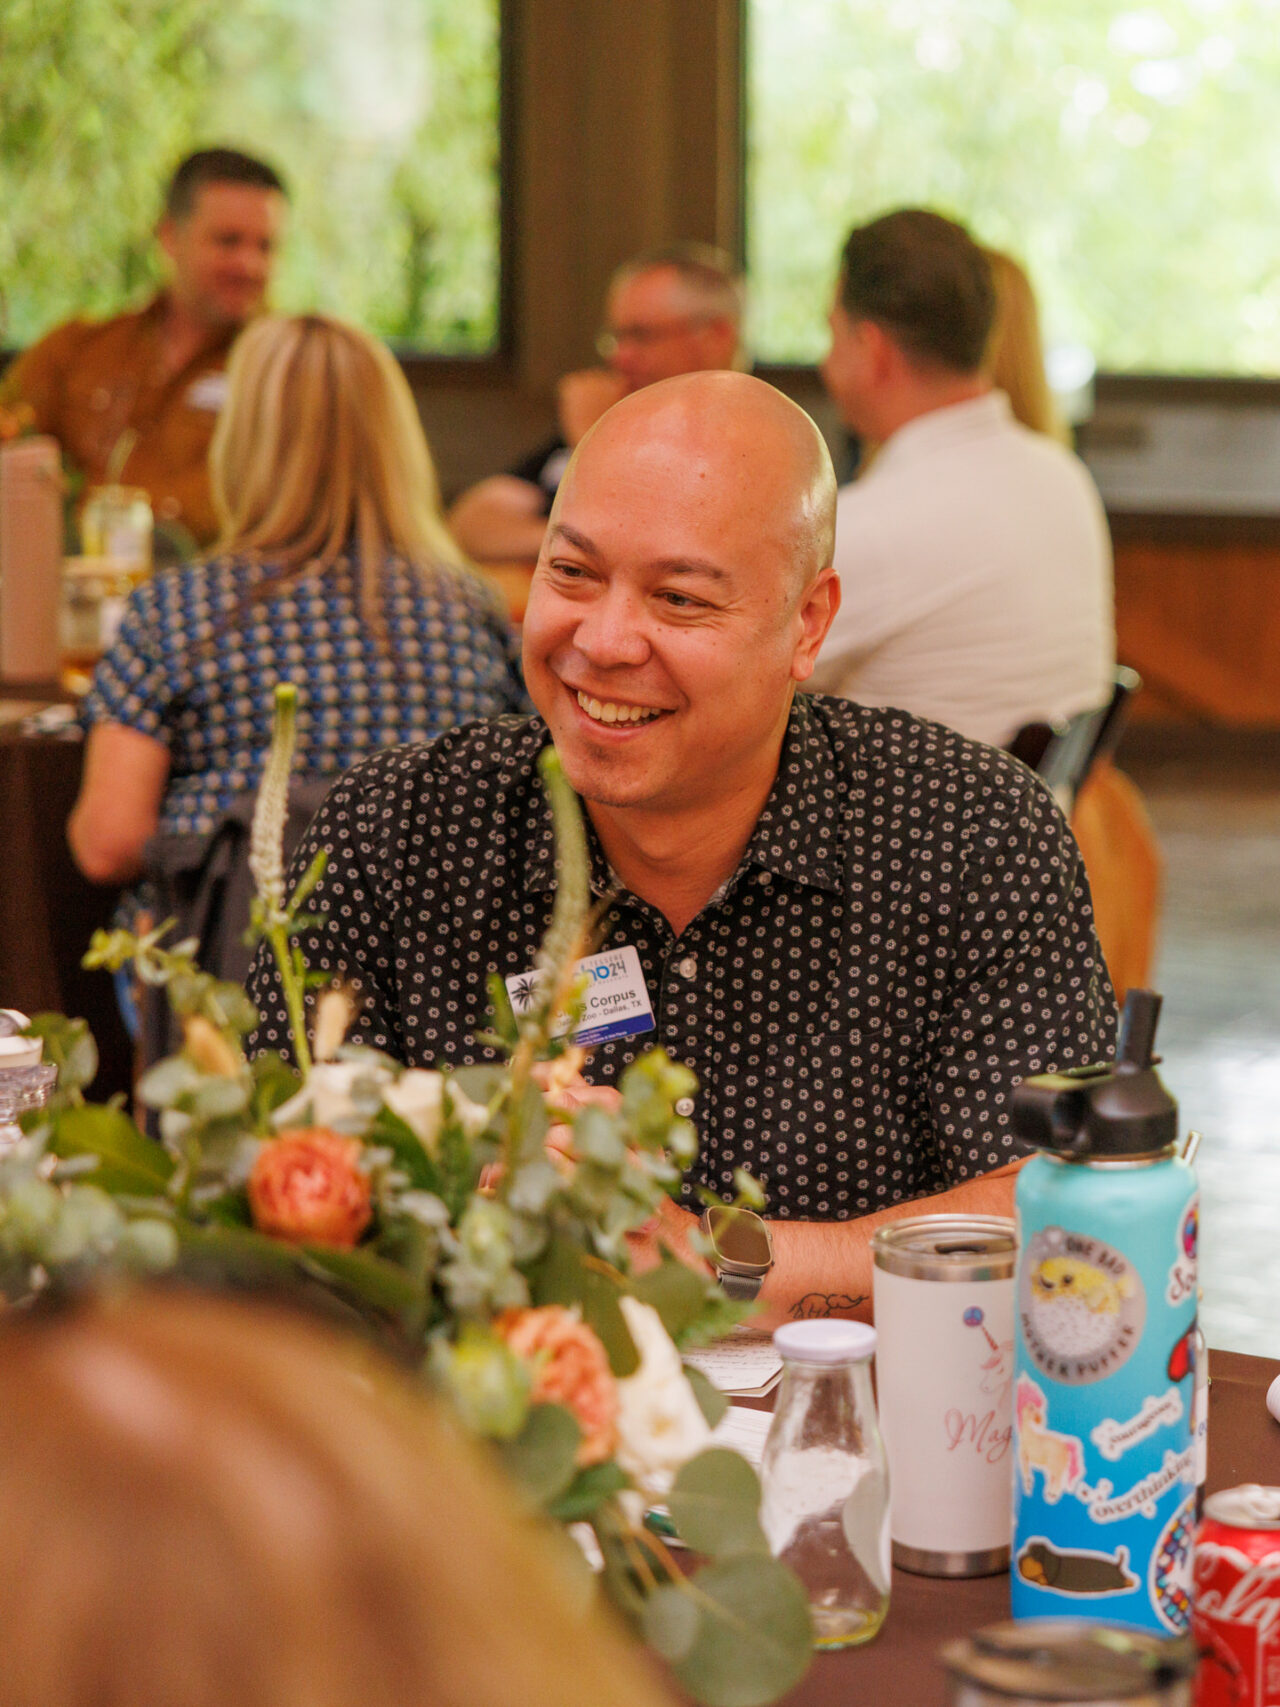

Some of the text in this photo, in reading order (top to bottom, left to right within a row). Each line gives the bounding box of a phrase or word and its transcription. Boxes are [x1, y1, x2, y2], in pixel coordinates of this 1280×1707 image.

[590, 990, 636, 1008] Corpus
[582, 1012, 598, 1022] Zoo
[603, 1004, 630, 1016] Dallas,
[631, 1000, 642, 1008] TX
